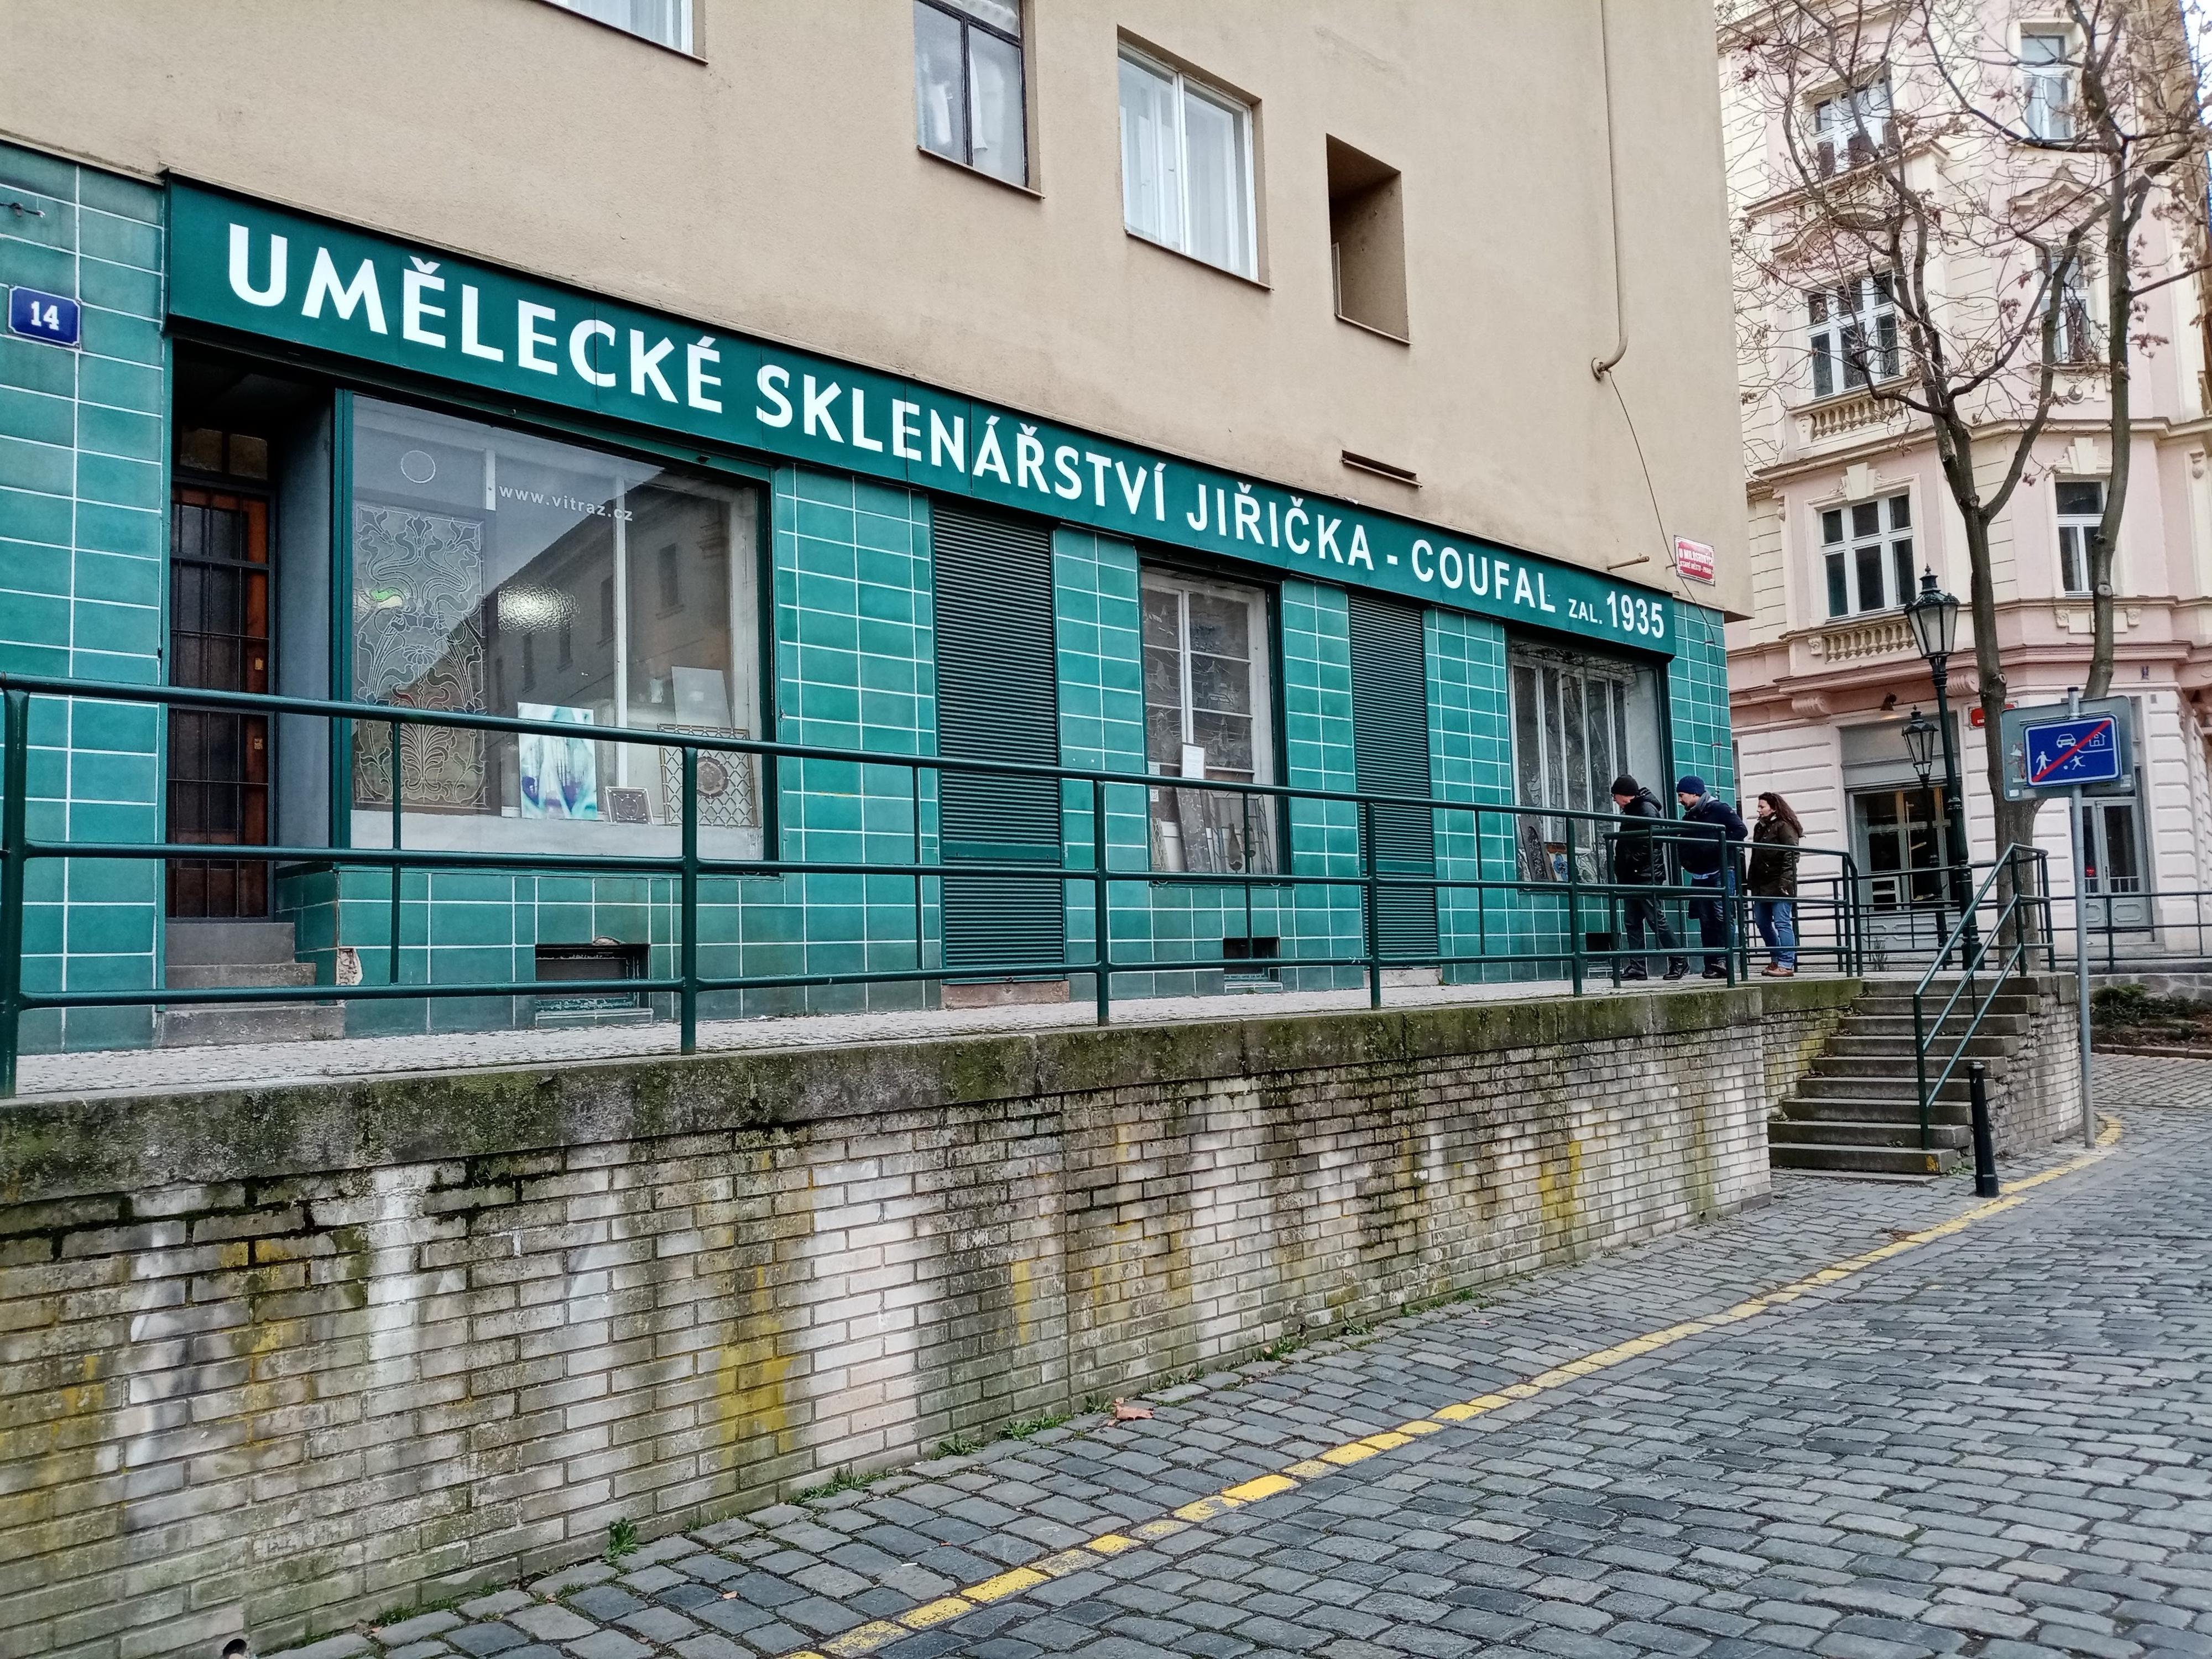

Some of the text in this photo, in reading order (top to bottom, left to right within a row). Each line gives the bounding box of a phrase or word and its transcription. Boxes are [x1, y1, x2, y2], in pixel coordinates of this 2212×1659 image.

[31, 301, 59, 331] 14
[228, 222, 1664, 638] UMĚLECKÉ SKLENÁŘSTVÍ JIŘIČKA - COUFAL ZAL. 1935
[499, 486, 633, 521] www.vitraz.cz
